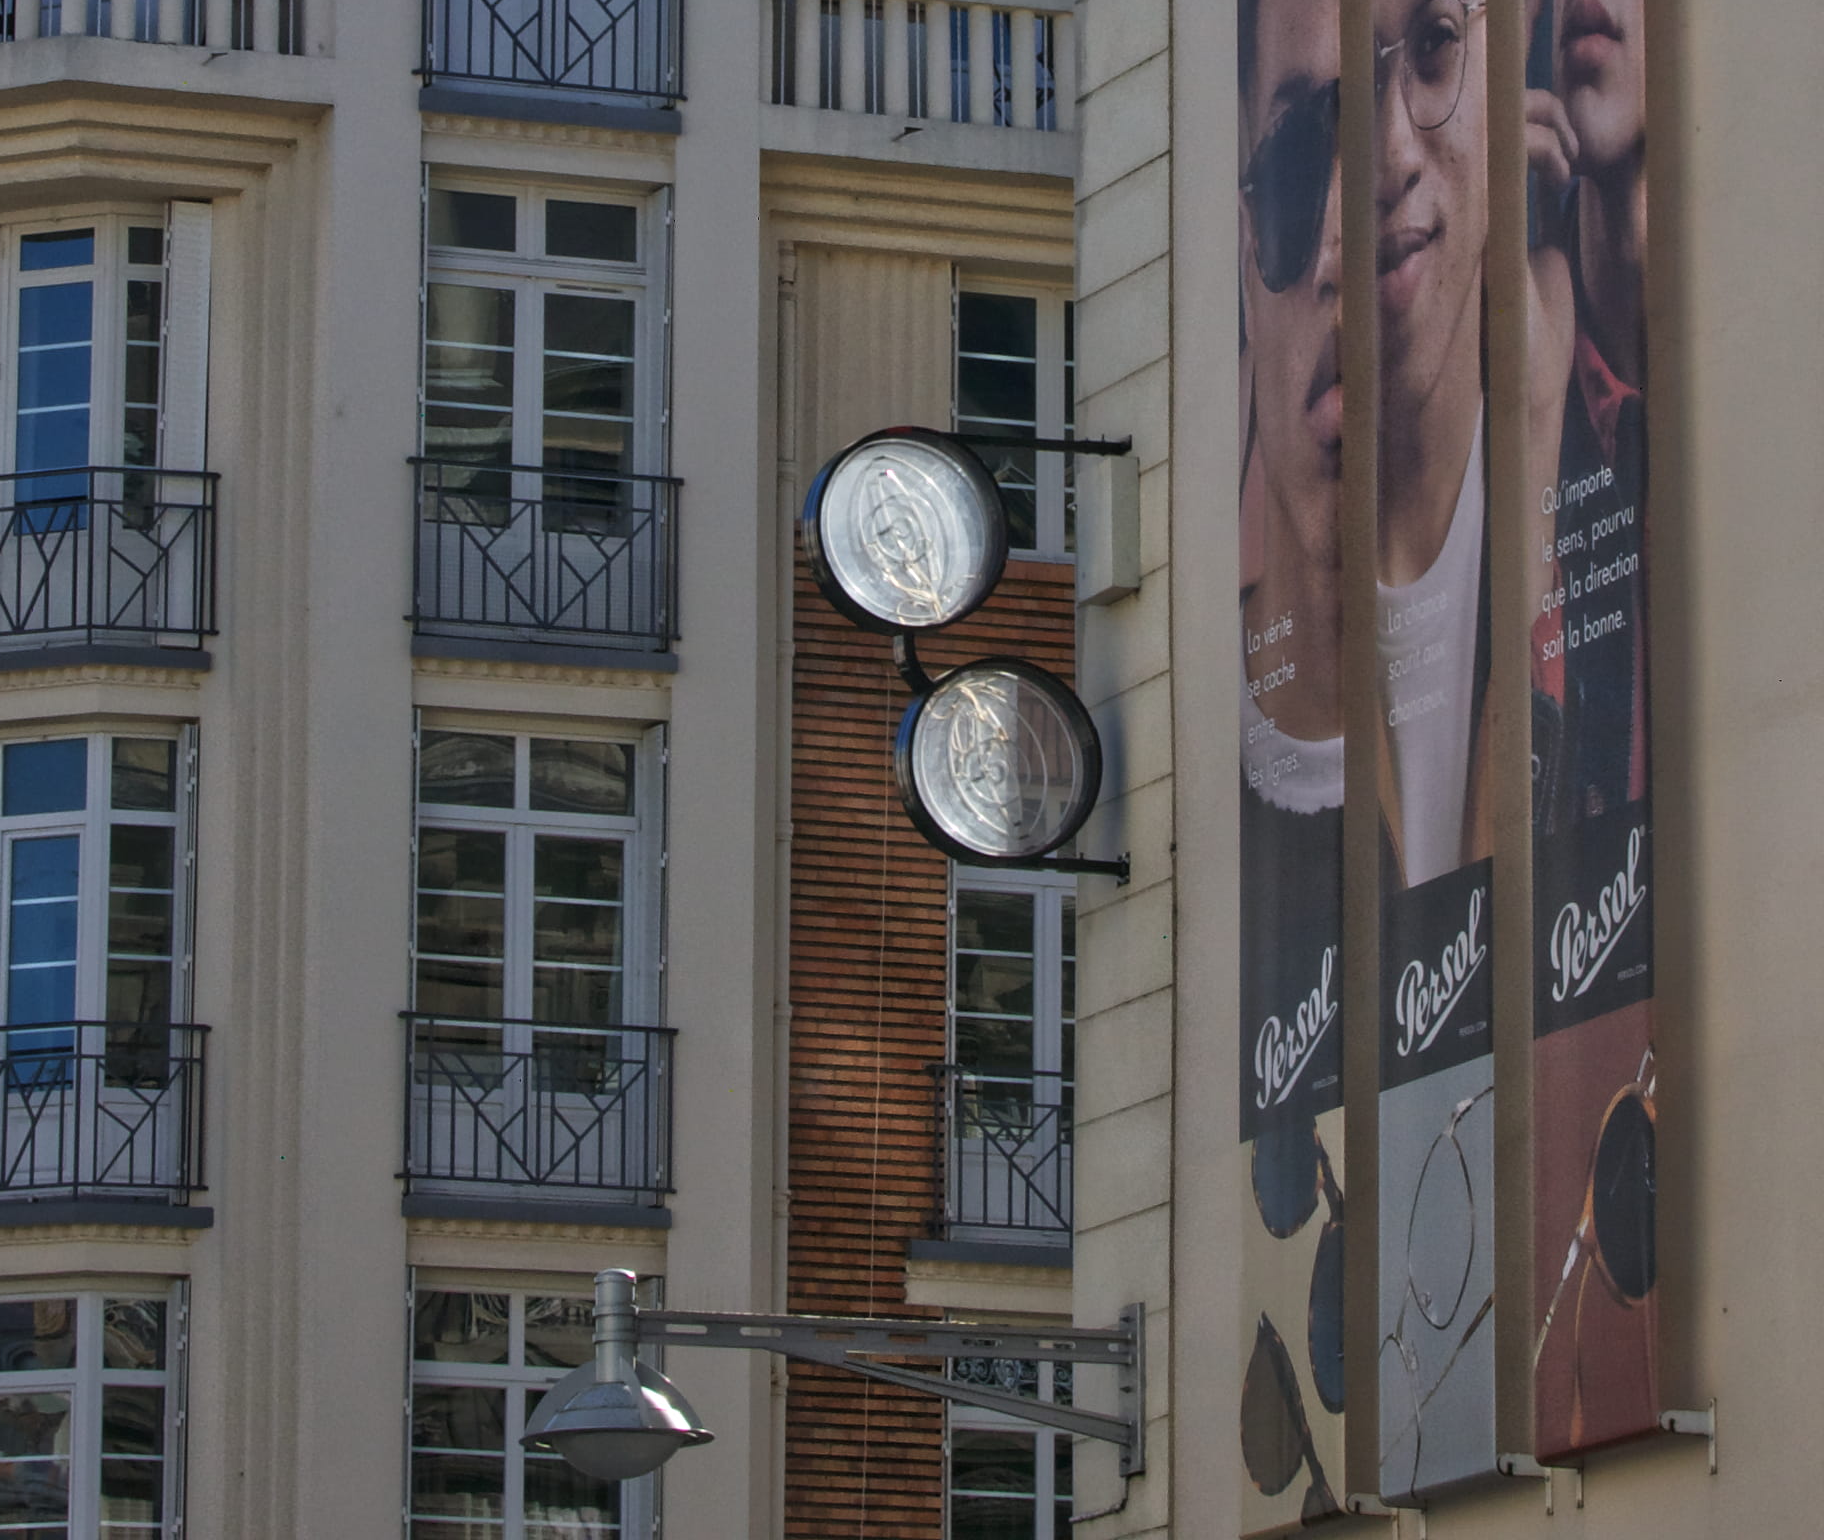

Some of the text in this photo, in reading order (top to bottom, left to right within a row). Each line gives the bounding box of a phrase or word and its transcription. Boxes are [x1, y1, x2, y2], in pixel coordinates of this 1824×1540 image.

[1541, 464, 1613, 514] Qu'importe
[1542, 505, 1634, 564] le sens, pourvu
[1542, 552, 1639, 618] que la direction
[1247, 611, 1293, 655] La vérité
[1387, 608, 1401, 633] La
[1542, 610, 1626, 661] soit la bonne.
[1248, 655, 1296, 699] se cache
[1551, 827, 1646, 1002] Persol
[1396, 889, 1487, 1057] Persol
[1255, 947, 1338, 1110] Persol
